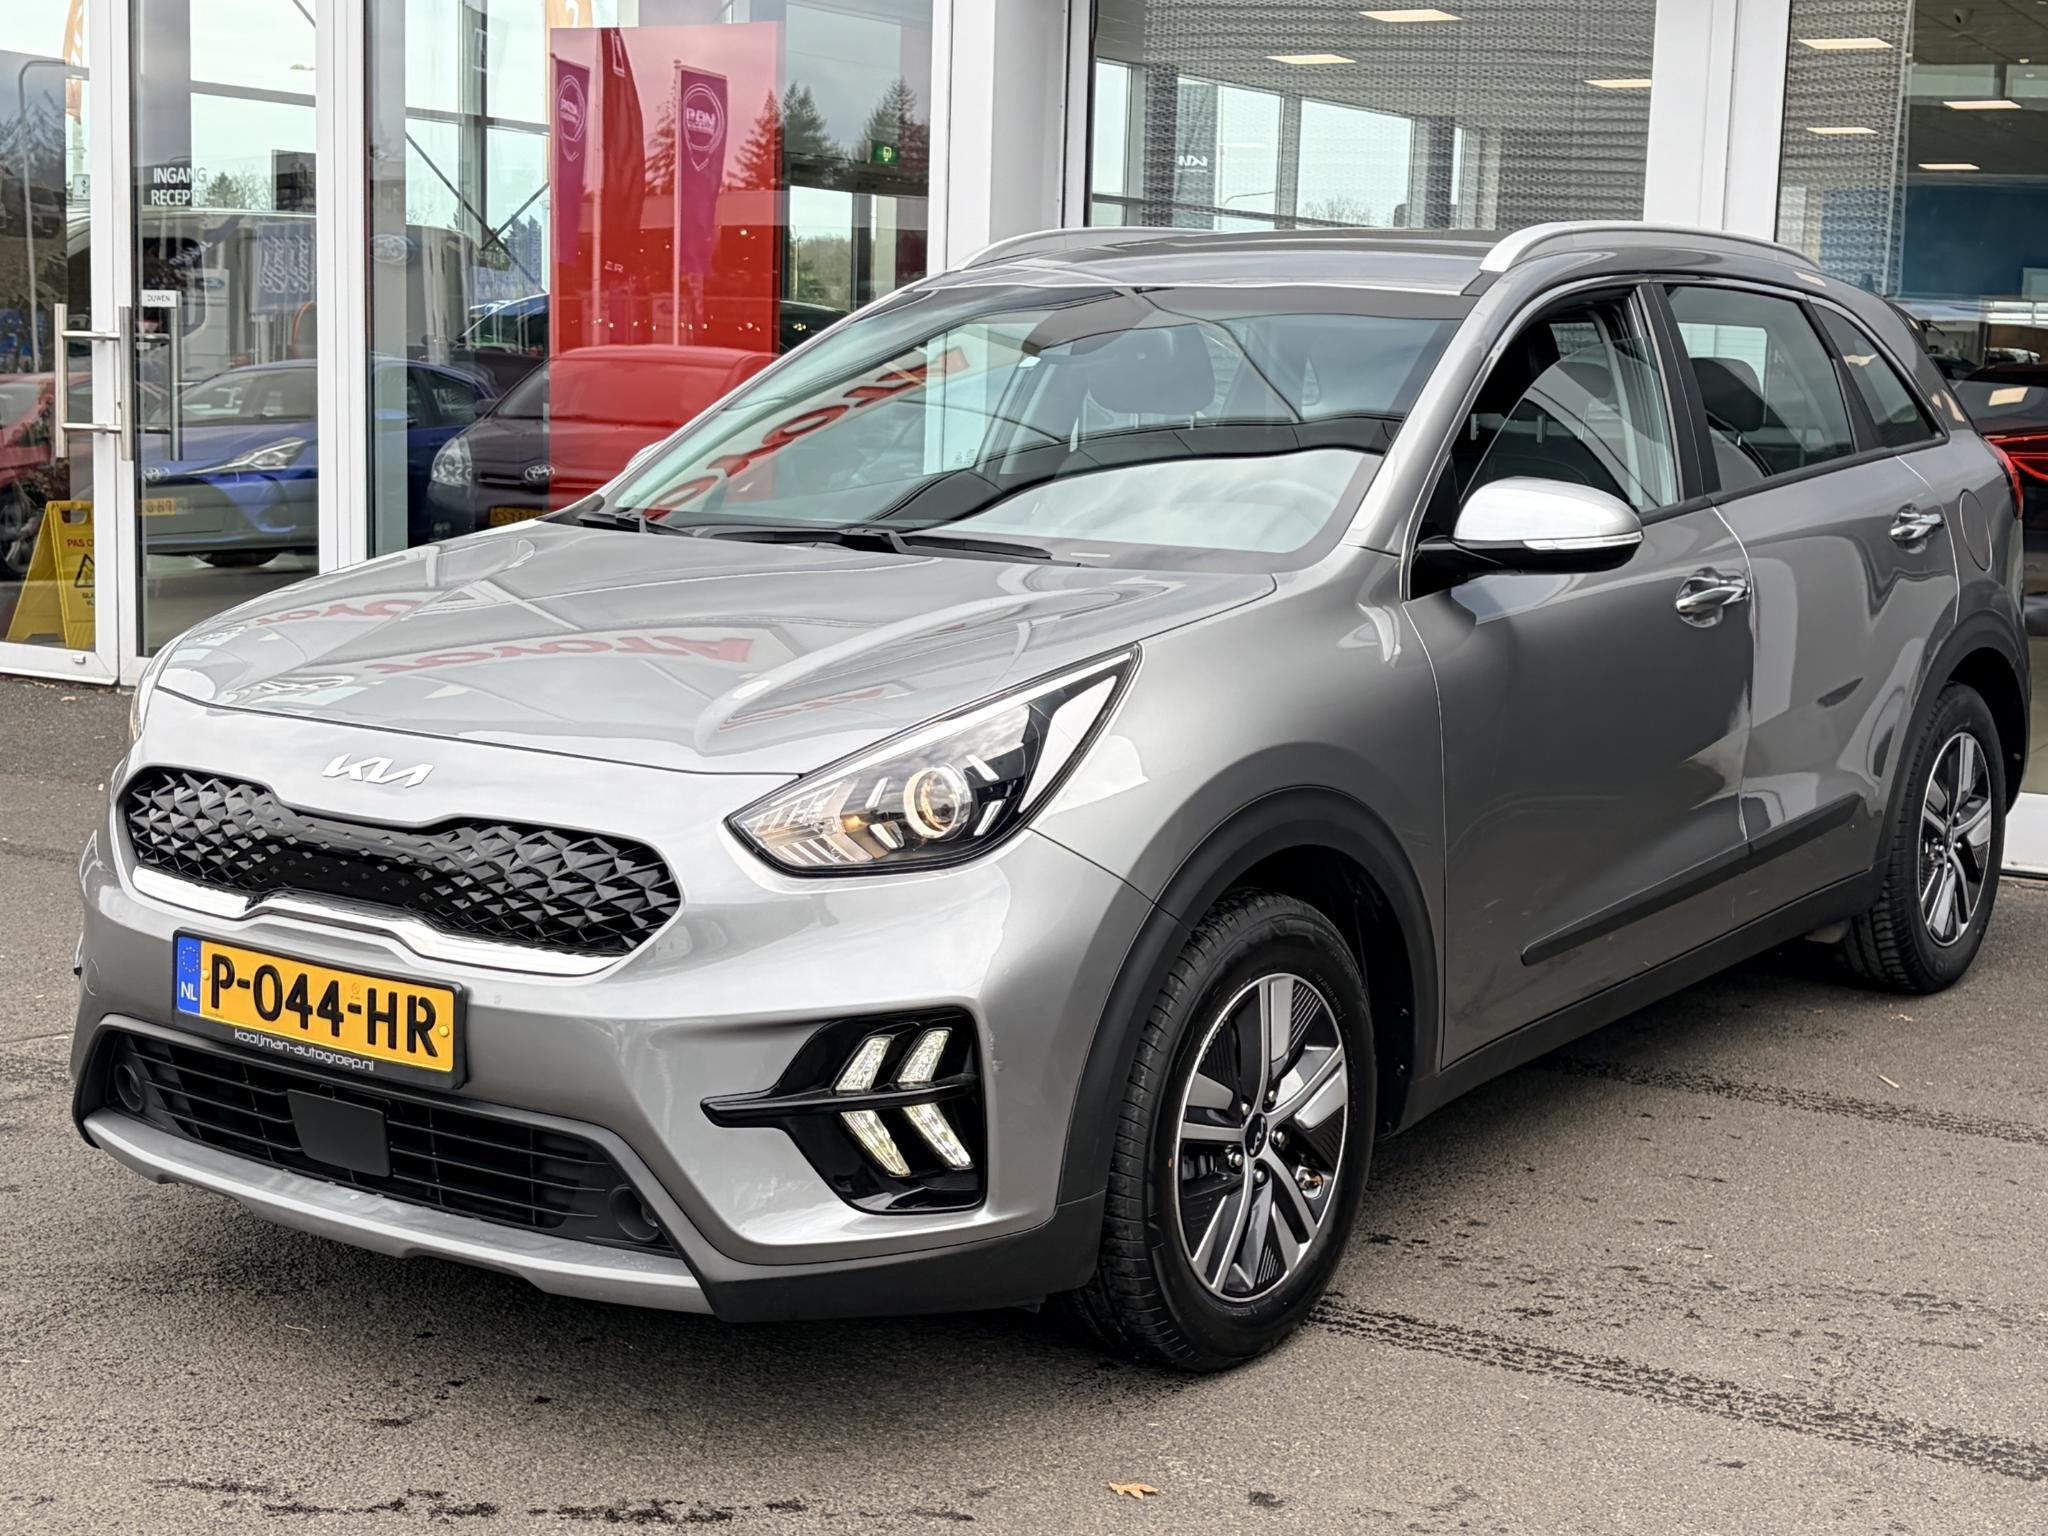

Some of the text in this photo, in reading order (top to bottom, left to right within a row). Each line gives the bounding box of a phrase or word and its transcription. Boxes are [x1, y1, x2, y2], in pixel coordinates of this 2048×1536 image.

[153, 167, 207, 184] INGANG
[181, 981, 198, 1002] NL
[211, 953, 438, 1058] P-044-HR
[234, 1028, 375, 1072] kooijman-autogroep.nl
